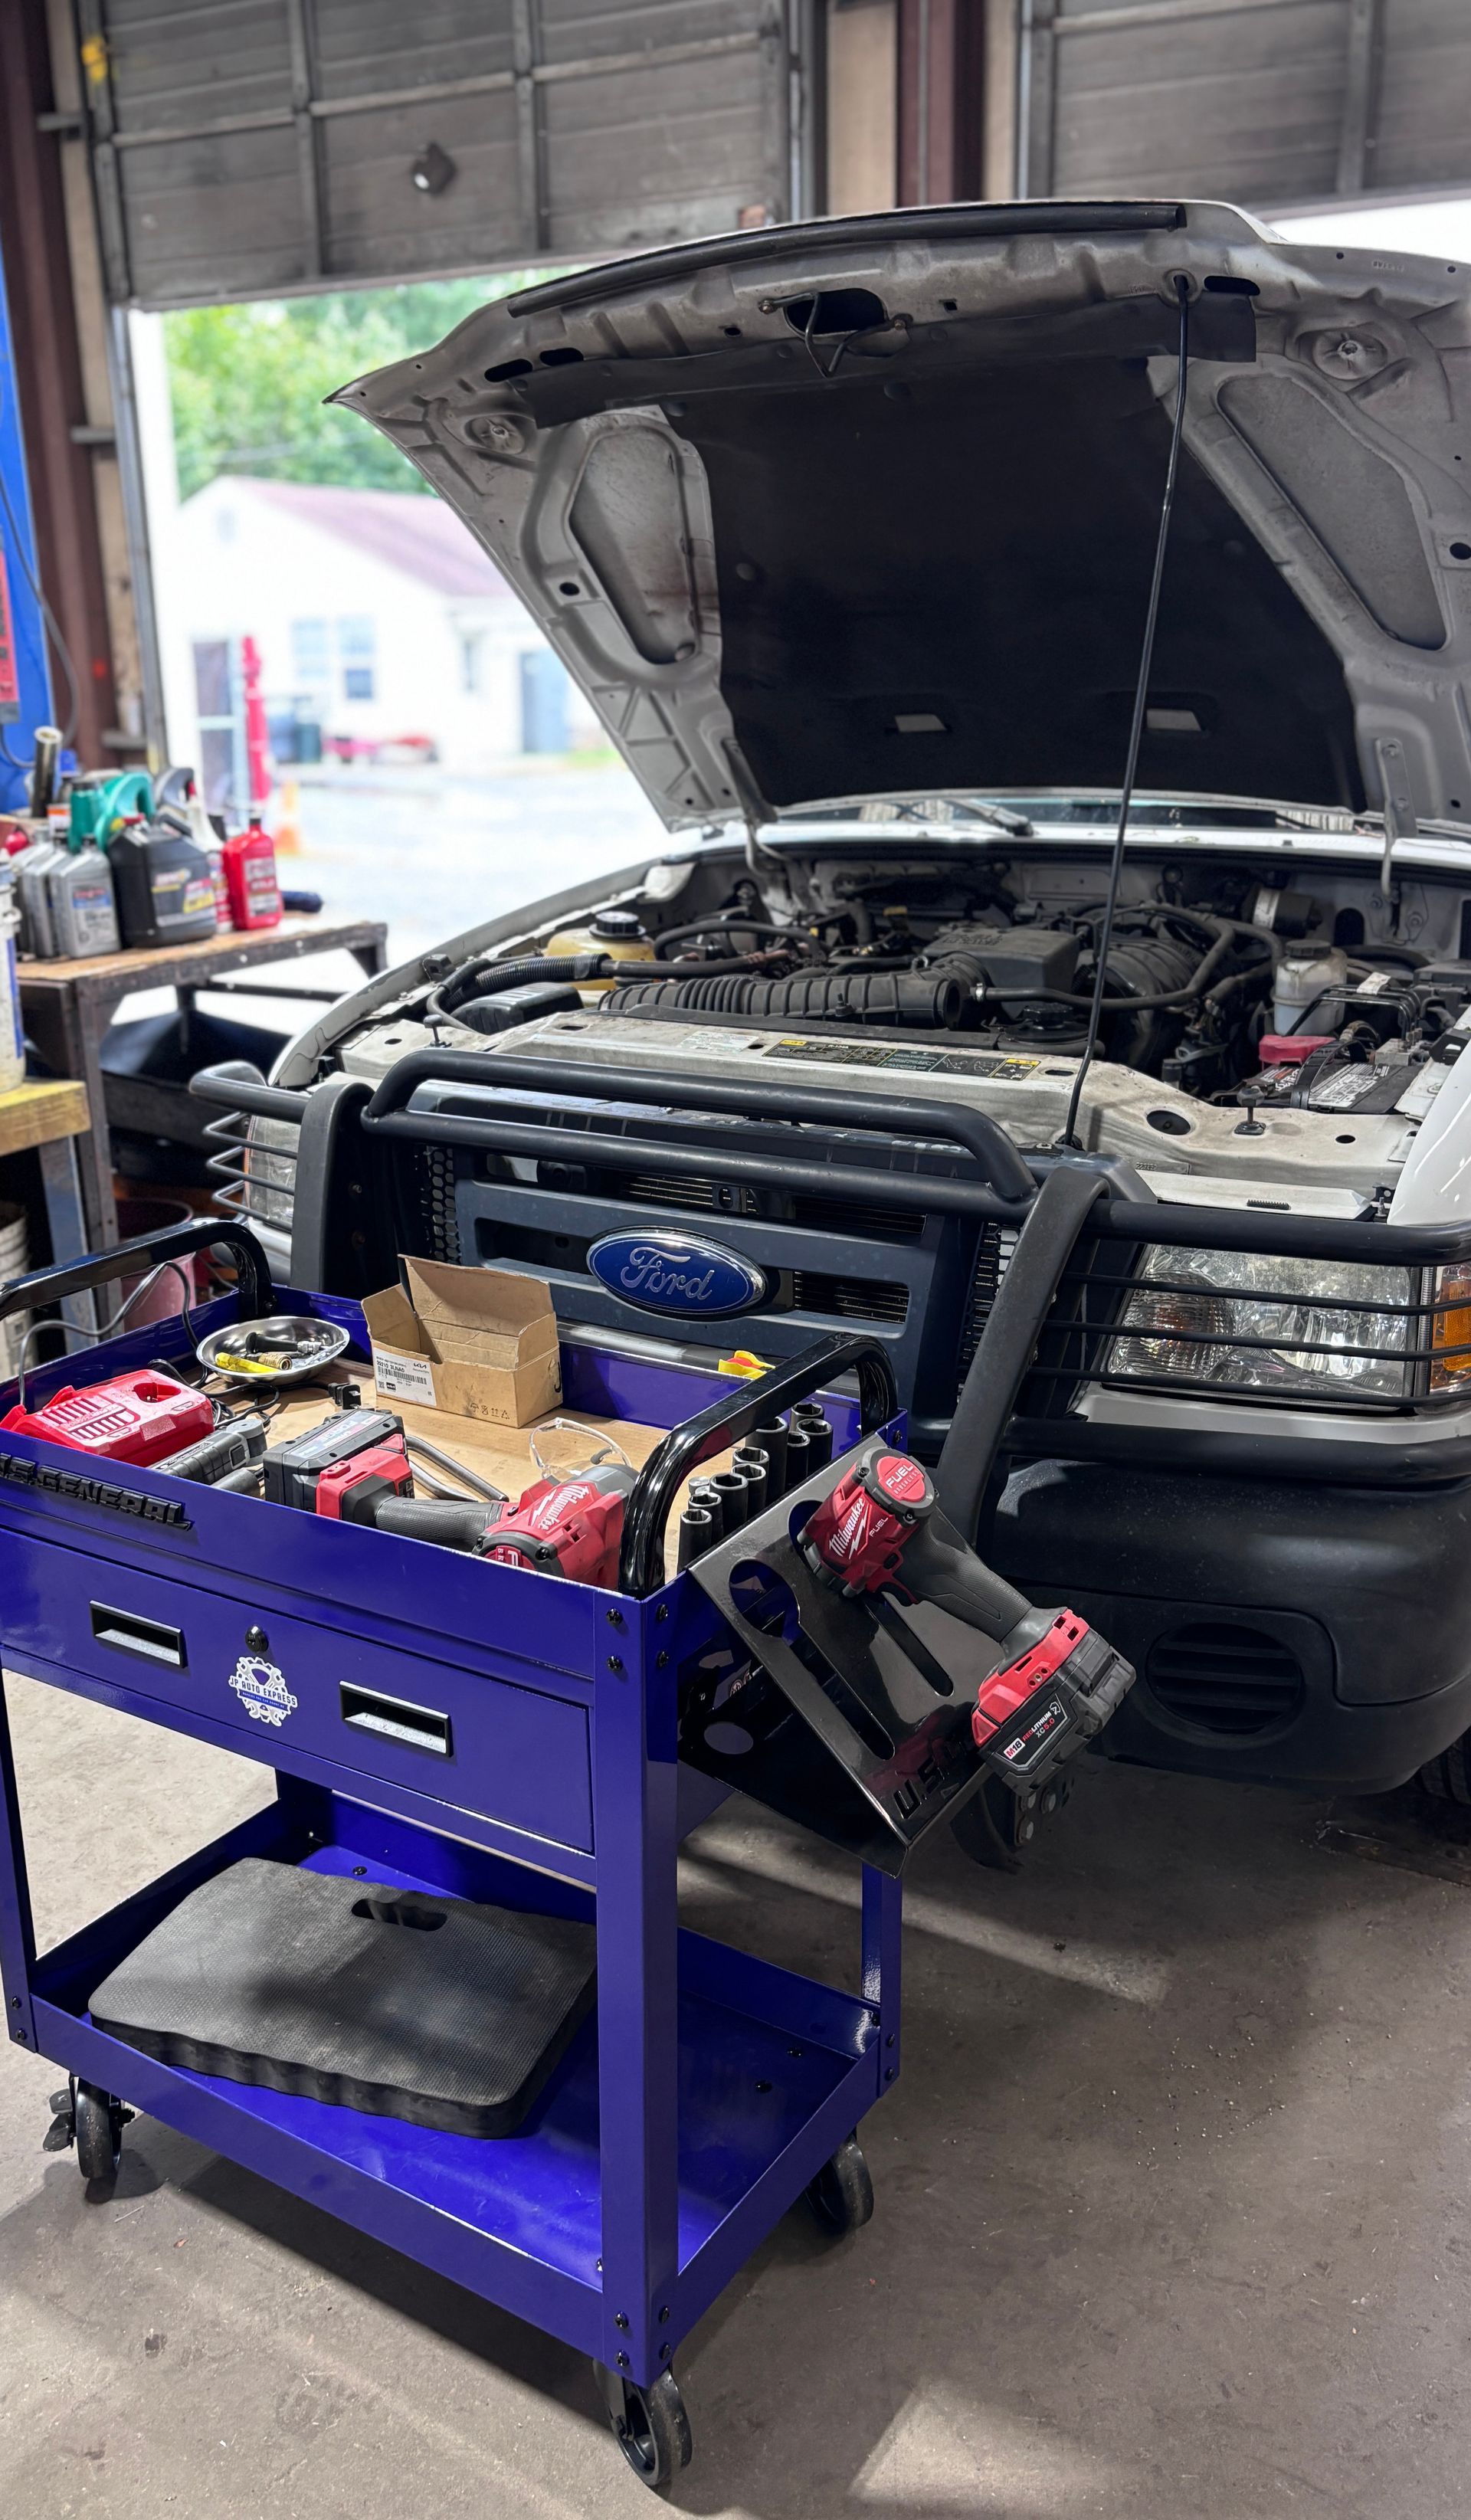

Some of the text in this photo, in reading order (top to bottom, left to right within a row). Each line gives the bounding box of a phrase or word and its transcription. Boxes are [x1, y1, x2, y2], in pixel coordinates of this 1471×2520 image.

[620, 1247, 716, 1300] Ford
[886, 1463, 914, 1489] FUEL
[538, 1484, 589, 1531] Milwaukee
[829, 1497, 865, 1558] Milwaukee
[869, 1517, 889, 1538] FUEL
[230, 1676, 238, 1686] JP
[241, 1680, 260, 1694] AUTO
[264, 1687, 296, 1706] EXPRESS
[1006, 1711, 1052, 1757] M18 REDLITHIUM
